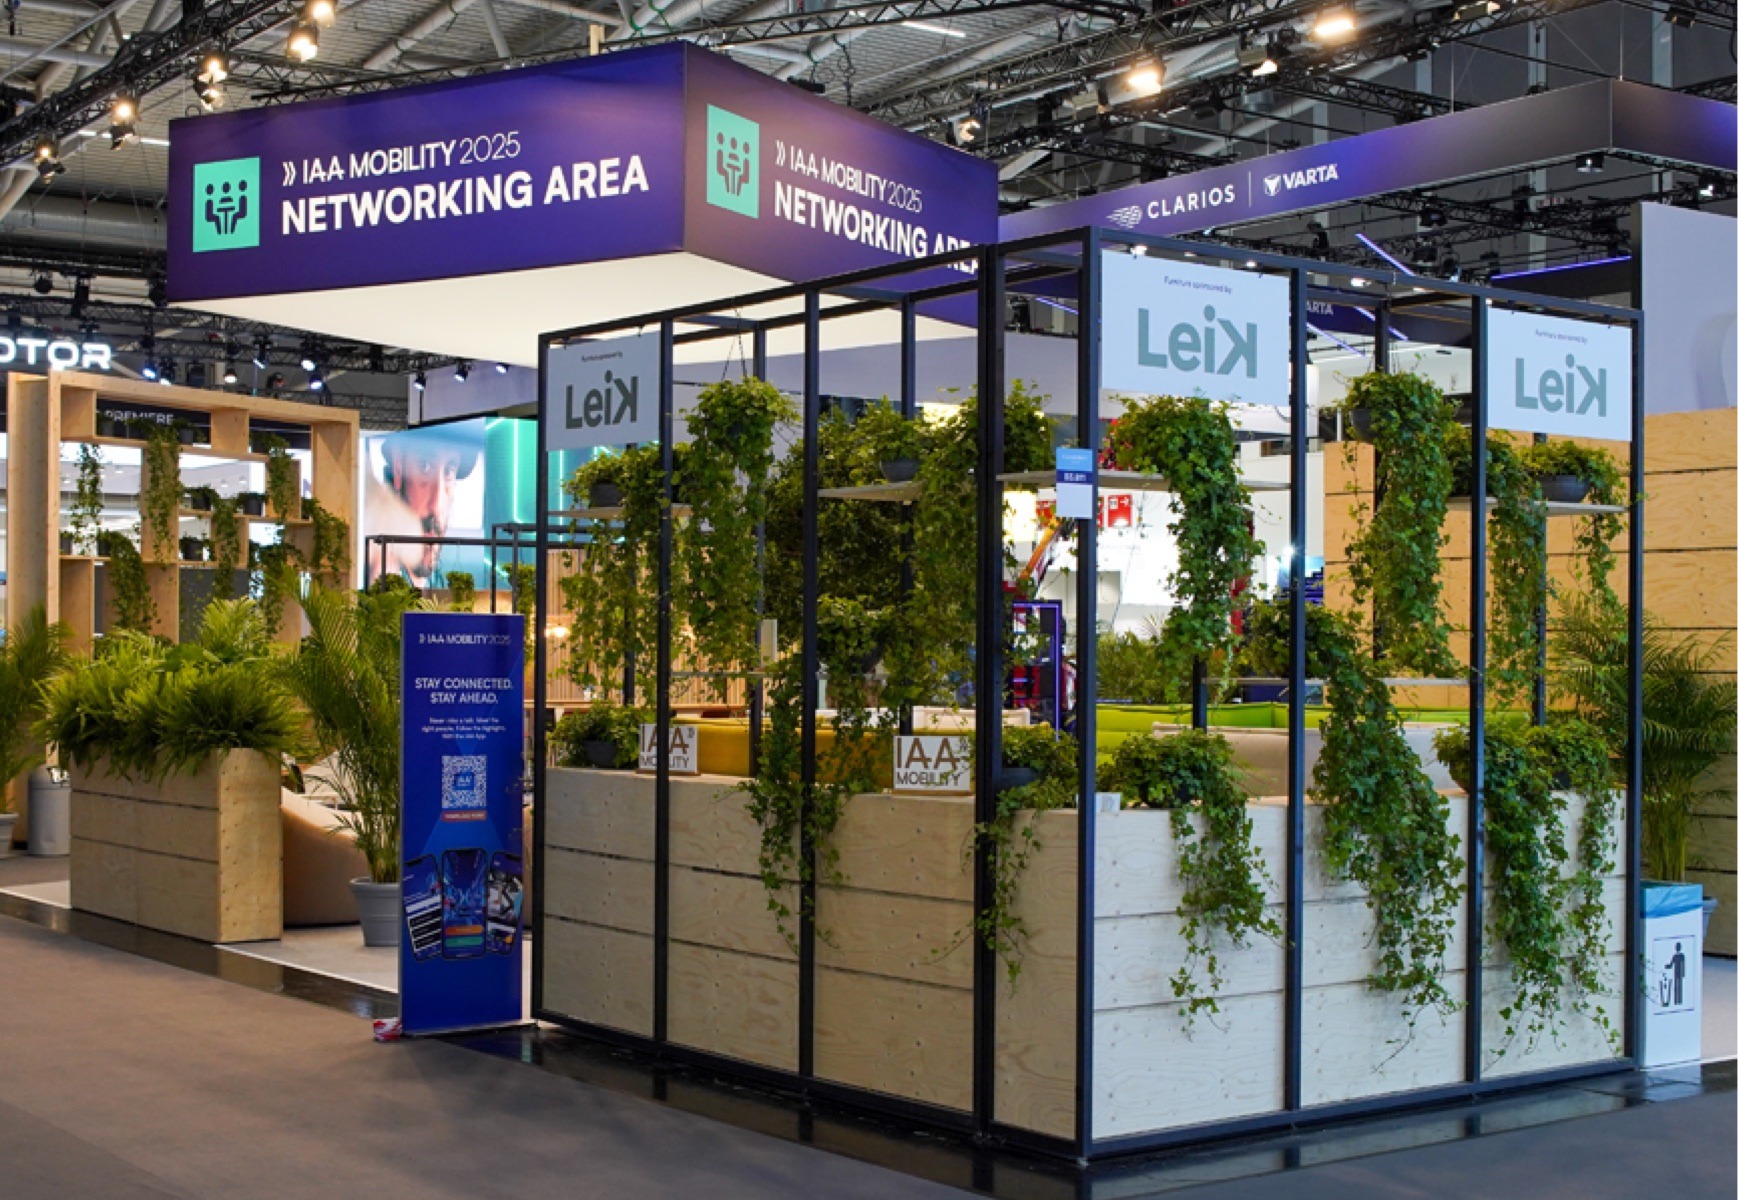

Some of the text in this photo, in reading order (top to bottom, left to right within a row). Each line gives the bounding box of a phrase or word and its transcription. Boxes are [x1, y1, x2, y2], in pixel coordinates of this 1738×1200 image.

[303, 131, 521, 185] IAA MOBILITY 2025
[790, 146, 922, 213] IAA MOBILITY 2025
[282, 155, 650, 235] NETWORKING AREA
[1147, 163, 1339, 219] CLARIOS VARTA
[775, 181, 928, 259] NETWORKING
[1306, 299, 1334, 316] ARTA
[446, 633, 489, 645] MOBILITY
[415, 677, 514, 690] STAY CONNECTED.
[430, 692, 457, 705] STAY
[897, 737, 961, 771] IAA
